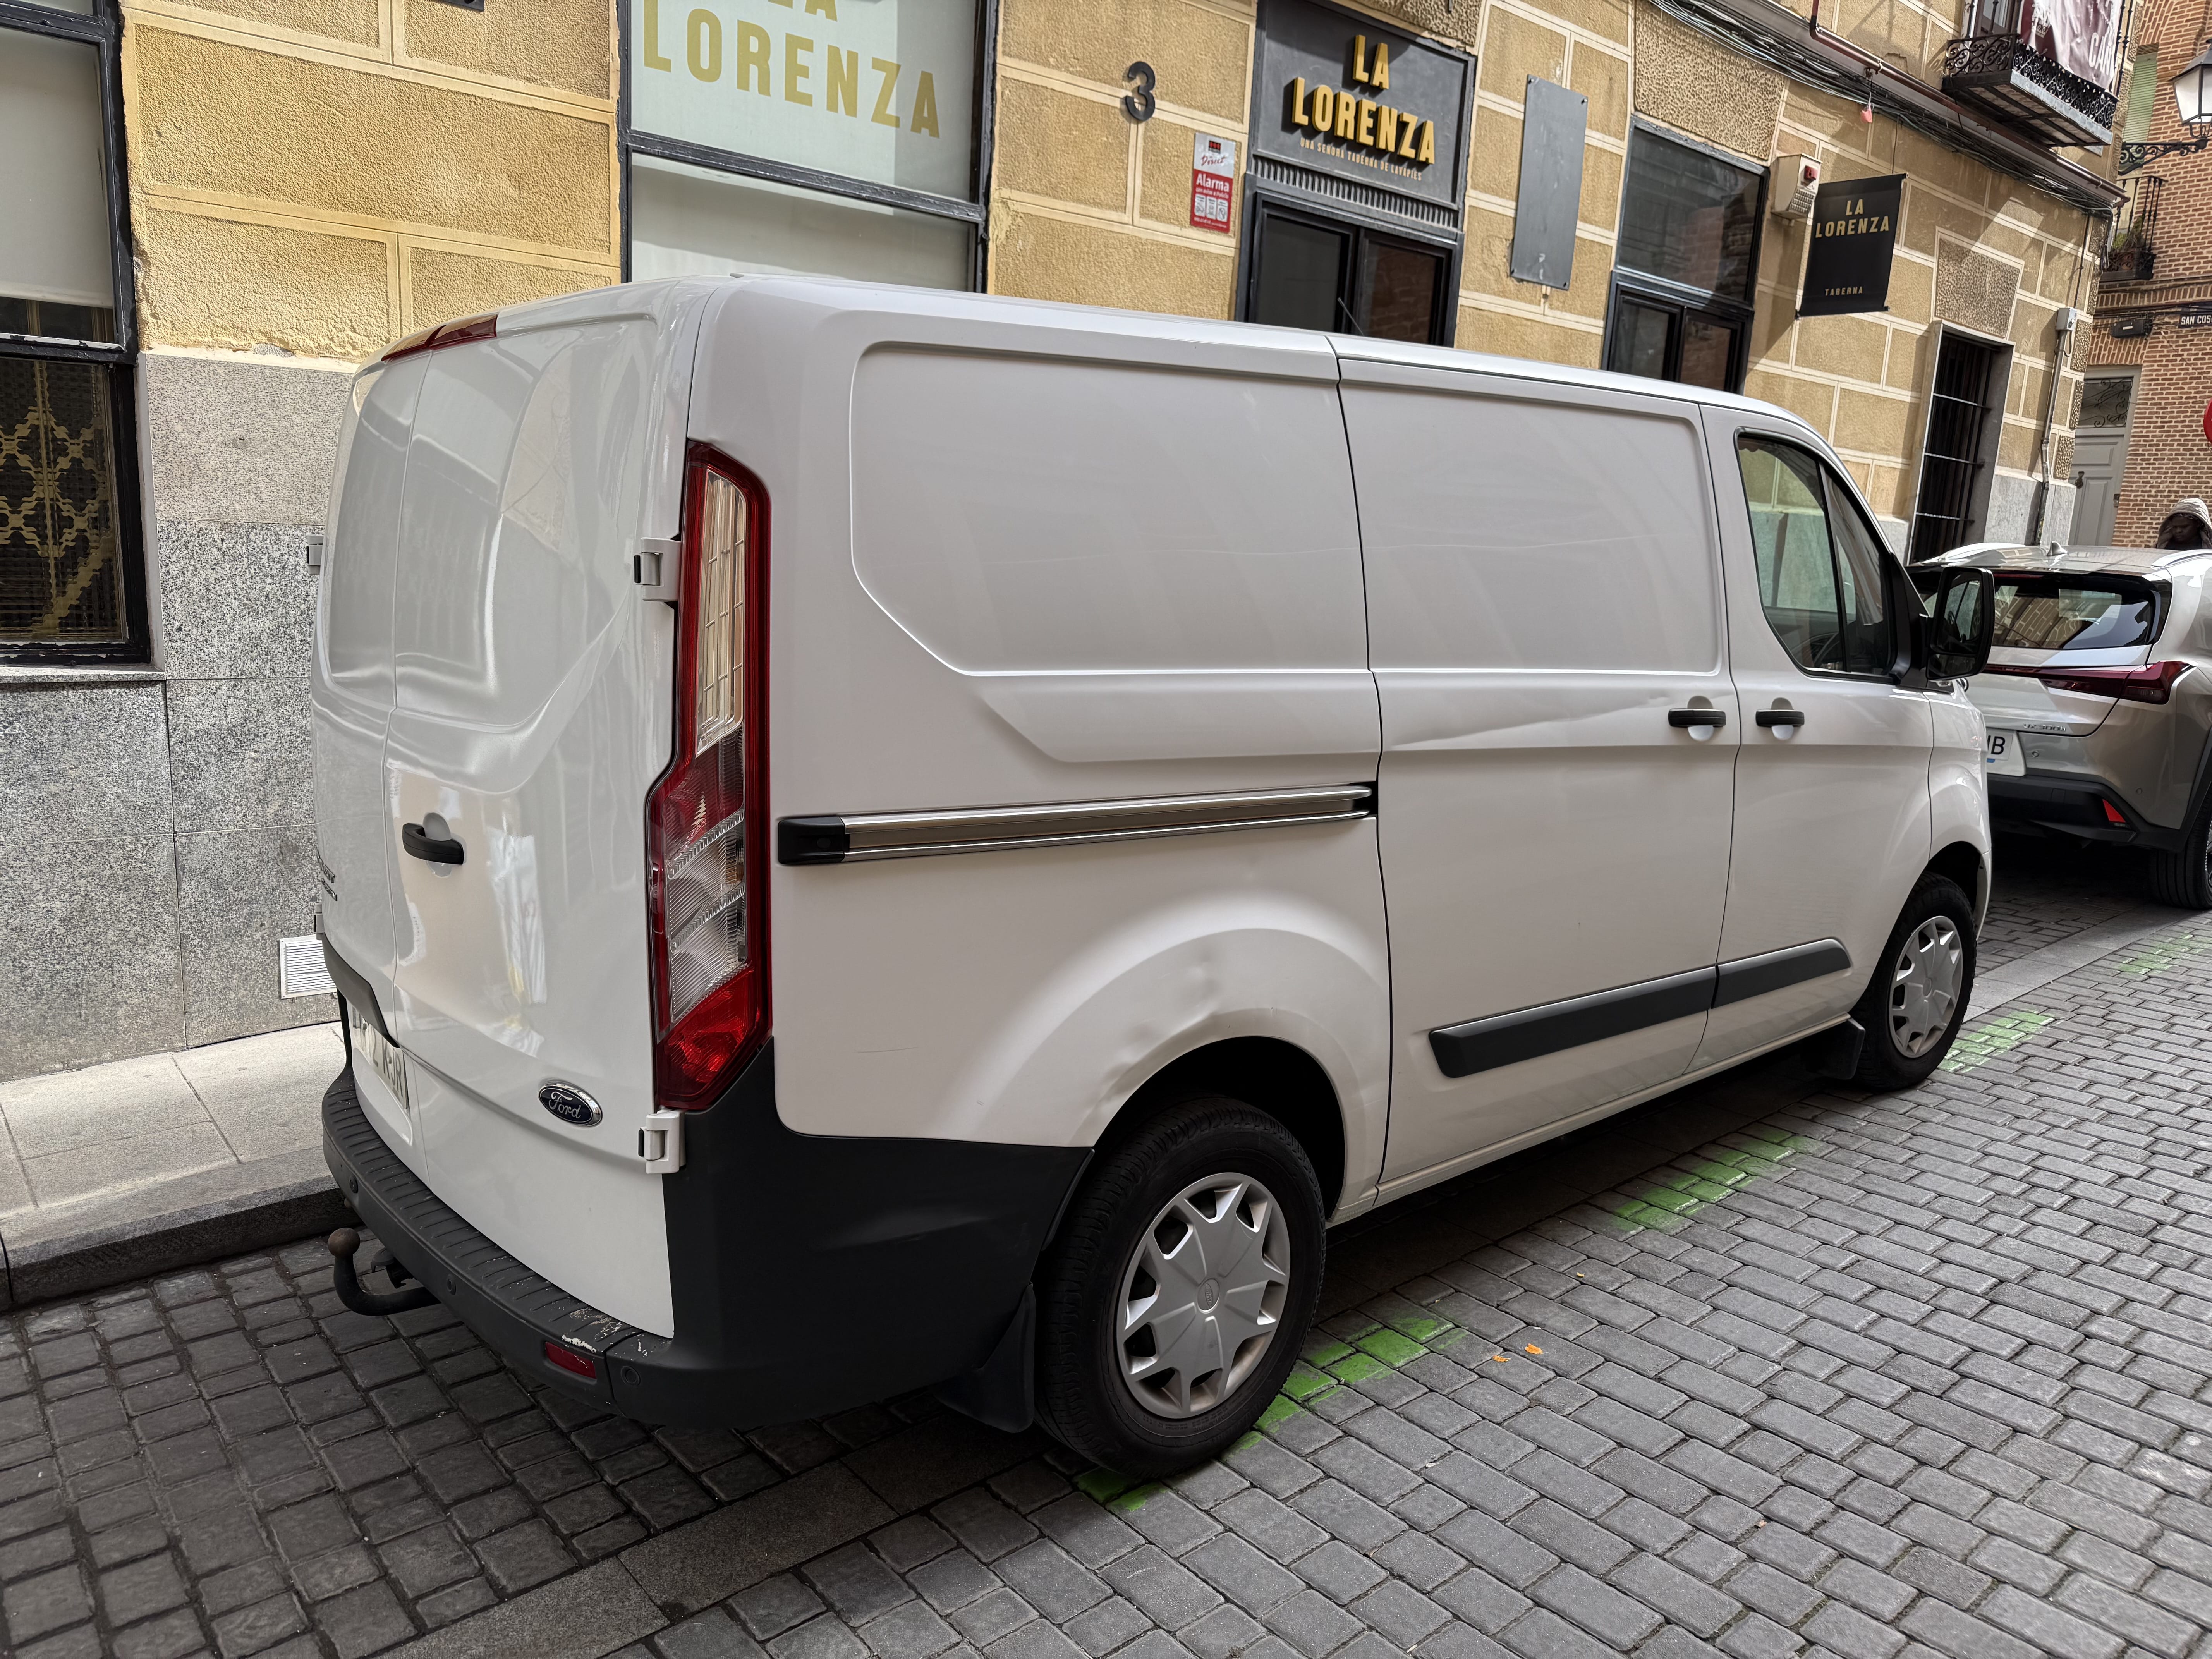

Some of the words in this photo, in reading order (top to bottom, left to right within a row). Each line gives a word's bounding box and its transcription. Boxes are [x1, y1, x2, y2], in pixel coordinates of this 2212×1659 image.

[644, 0, 940, 139] LORENZA
[1352, 34, 1389, 89] LA
[1125, 61, 1156, 122] 3
[1291, 77, 1435, 164] LORENZA
[1300, 137, 1314, 150] UNA
[1348, 151, 1378, 168] TABERNA
[1380, 160, 1389, 172] DE
[1196, 173, 1230, 192] Alarma
[1845, 199, 1864, 216] LA
[1815, 215, 1889, 238] LORENZA
[1825, 286, 1863, 296] TABERNA
[2181, 316, 2195, 325] SAN
[2197, 315, 2212, 324] COS
[548, 1091, 582, 1119] Ford
